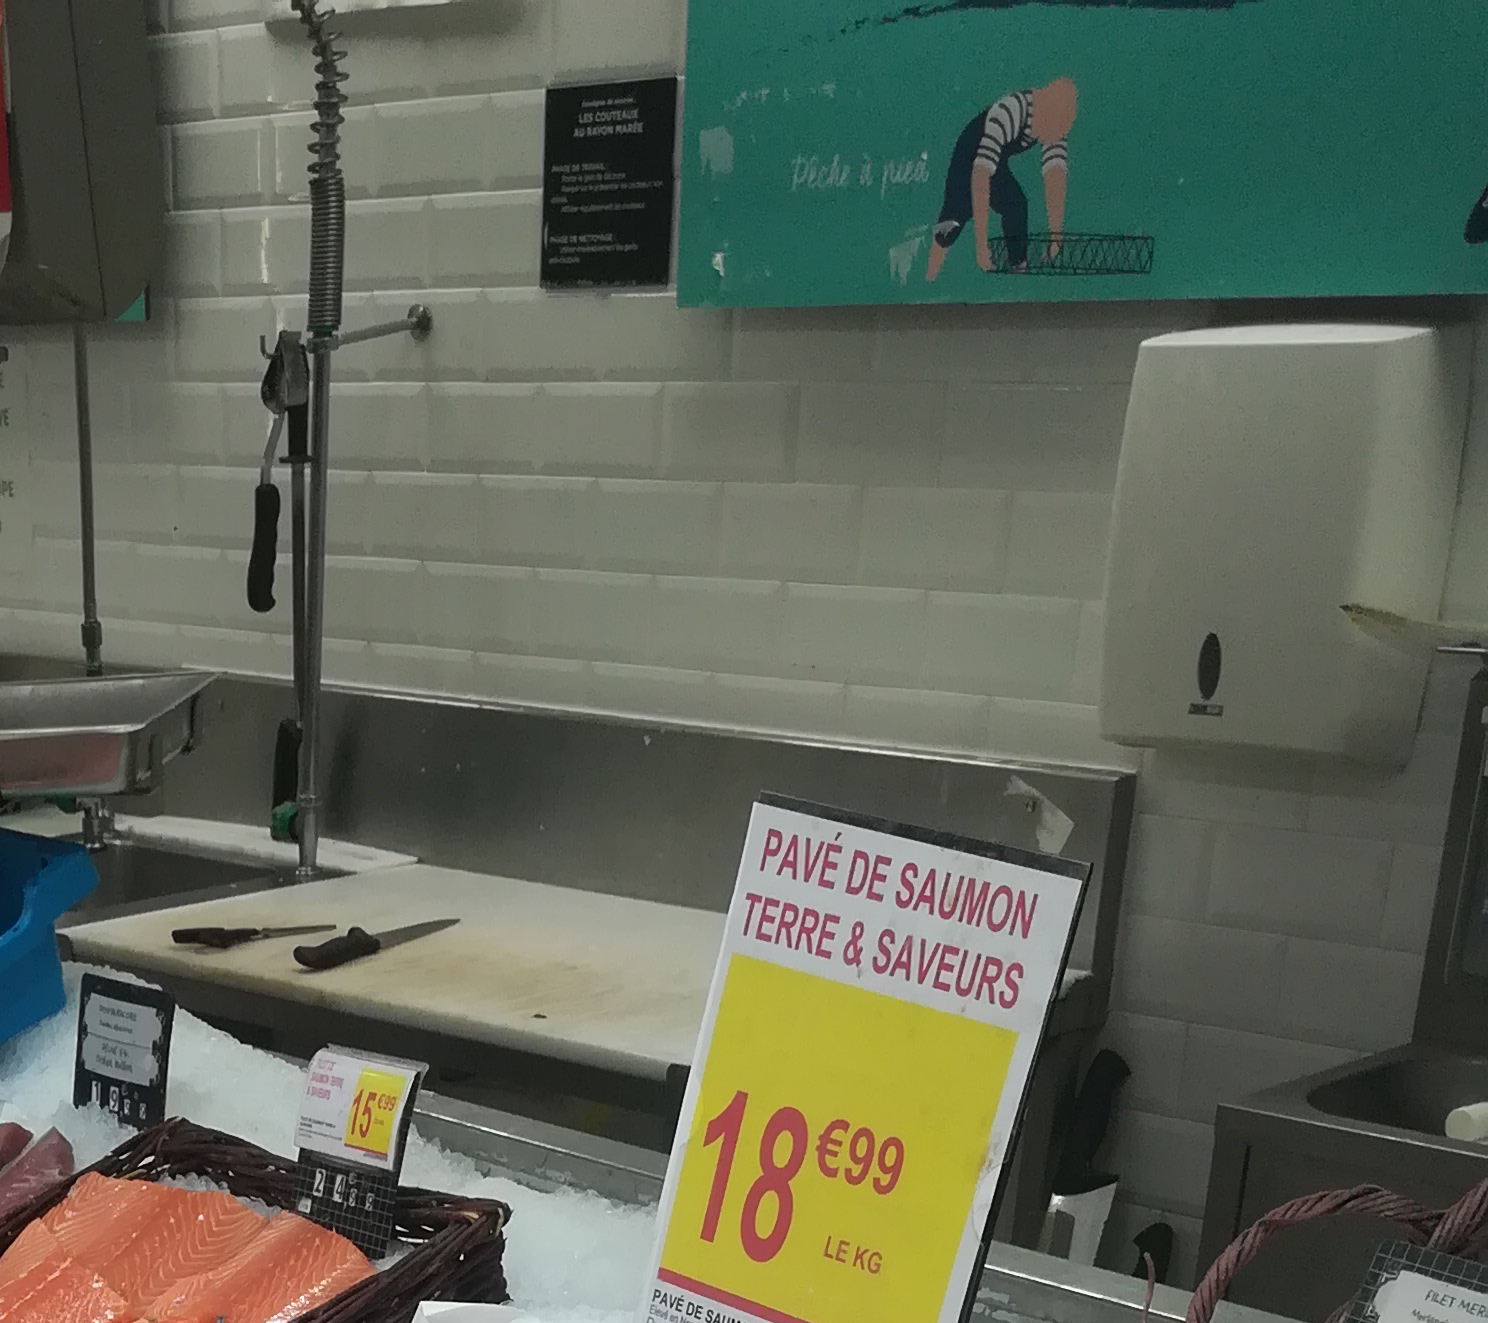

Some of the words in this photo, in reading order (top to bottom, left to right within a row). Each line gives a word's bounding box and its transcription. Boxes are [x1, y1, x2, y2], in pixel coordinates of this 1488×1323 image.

[760, 828, 842, 889] PAVÉ
[846, 848, 892, 902] DE
[894, 862, 1038, 941] SAUMON
[742, 892, 842, 961] TERRE
[841, 920, 866, 967] &
[871, 928, 1024, 1010] SAVEURS
[823, 1234, 850, 1266] LE
[852, 1244, 884, 1276] KG
[652, 1288, 686, 1313] PAVÉ
[685, 1304, 704, 1321] DE
[1424, 1288, 1457, 1308] FILET
